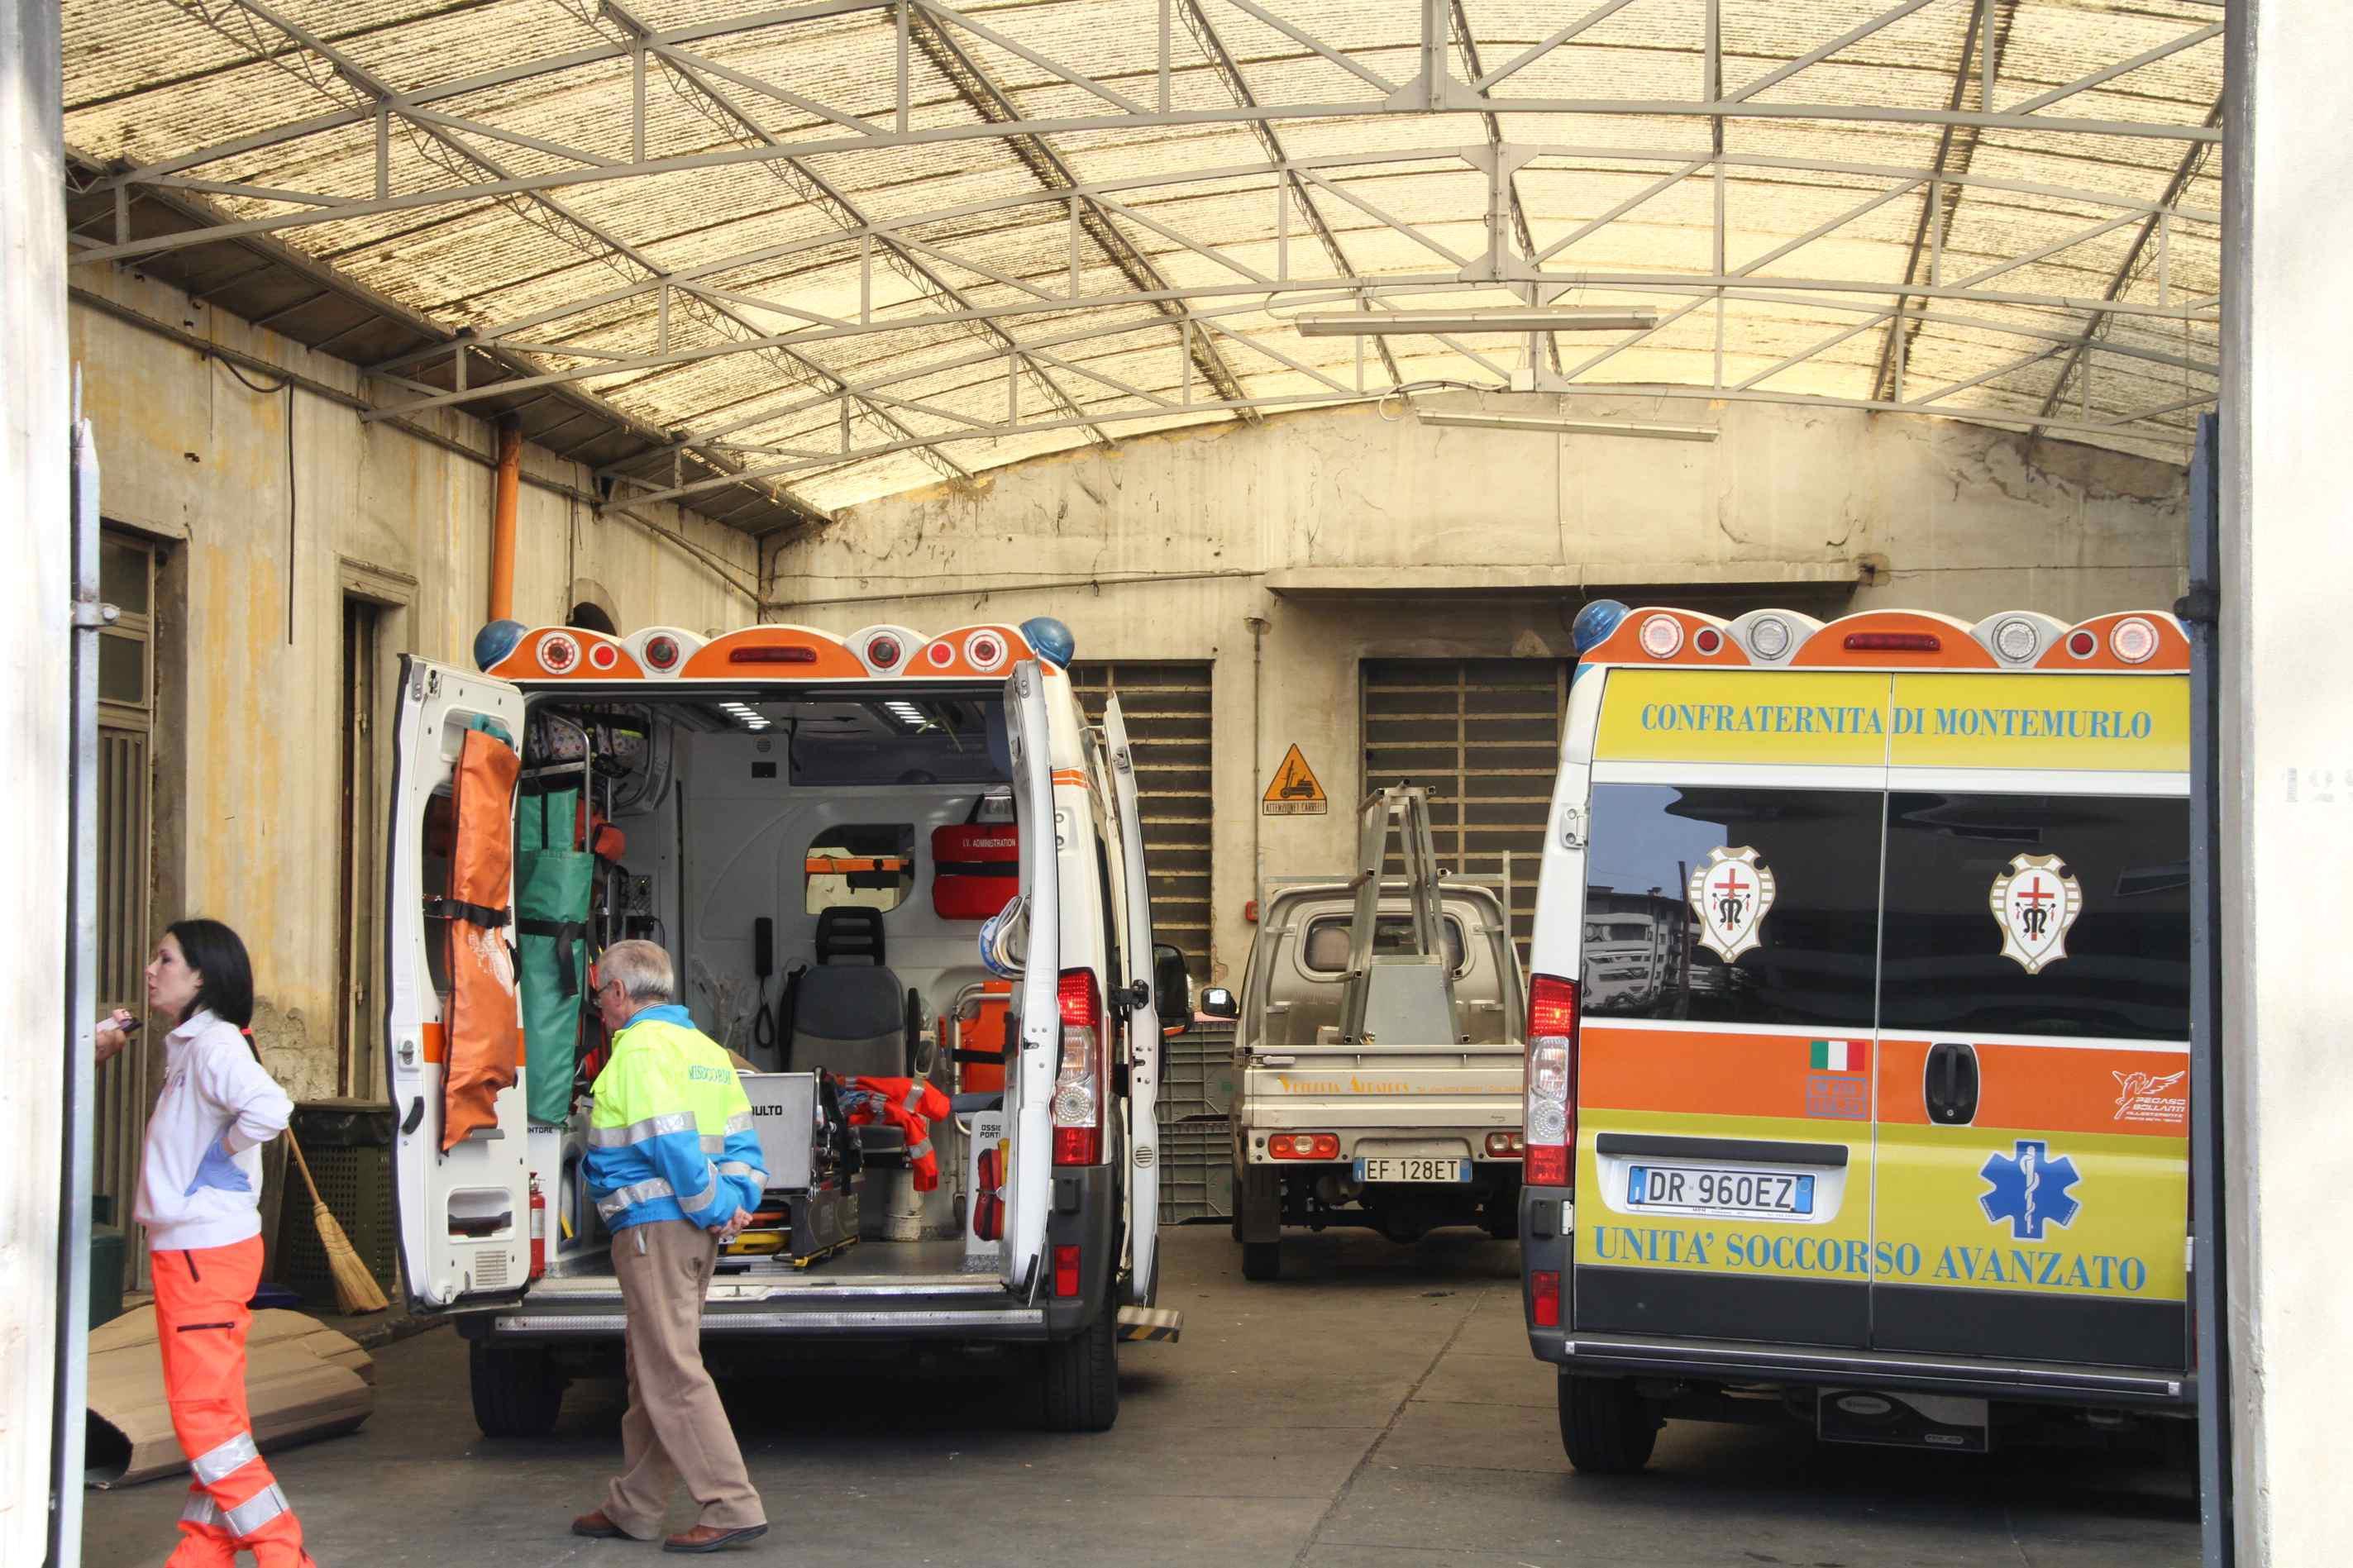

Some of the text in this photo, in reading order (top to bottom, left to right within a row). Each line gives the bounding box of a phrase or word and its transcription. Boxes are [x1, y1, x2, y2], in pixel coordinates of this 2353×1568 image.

[1641, 703, 2151, 738] CONFRATERNITA DI MONTEMURLO
[973, 839, 1016, 847] ADMINISTRATION
[1367, 1161, 1390, 1180] EF
[1401, 1161, 1458, 1180] 128ET
[1649, 1171, 1686, 1203] DR
[1697, 1174, 1794, 1209] 960EZ
[1592, 1226, 2147, 1291] UNITA' SOCCORSO AVANZATO
